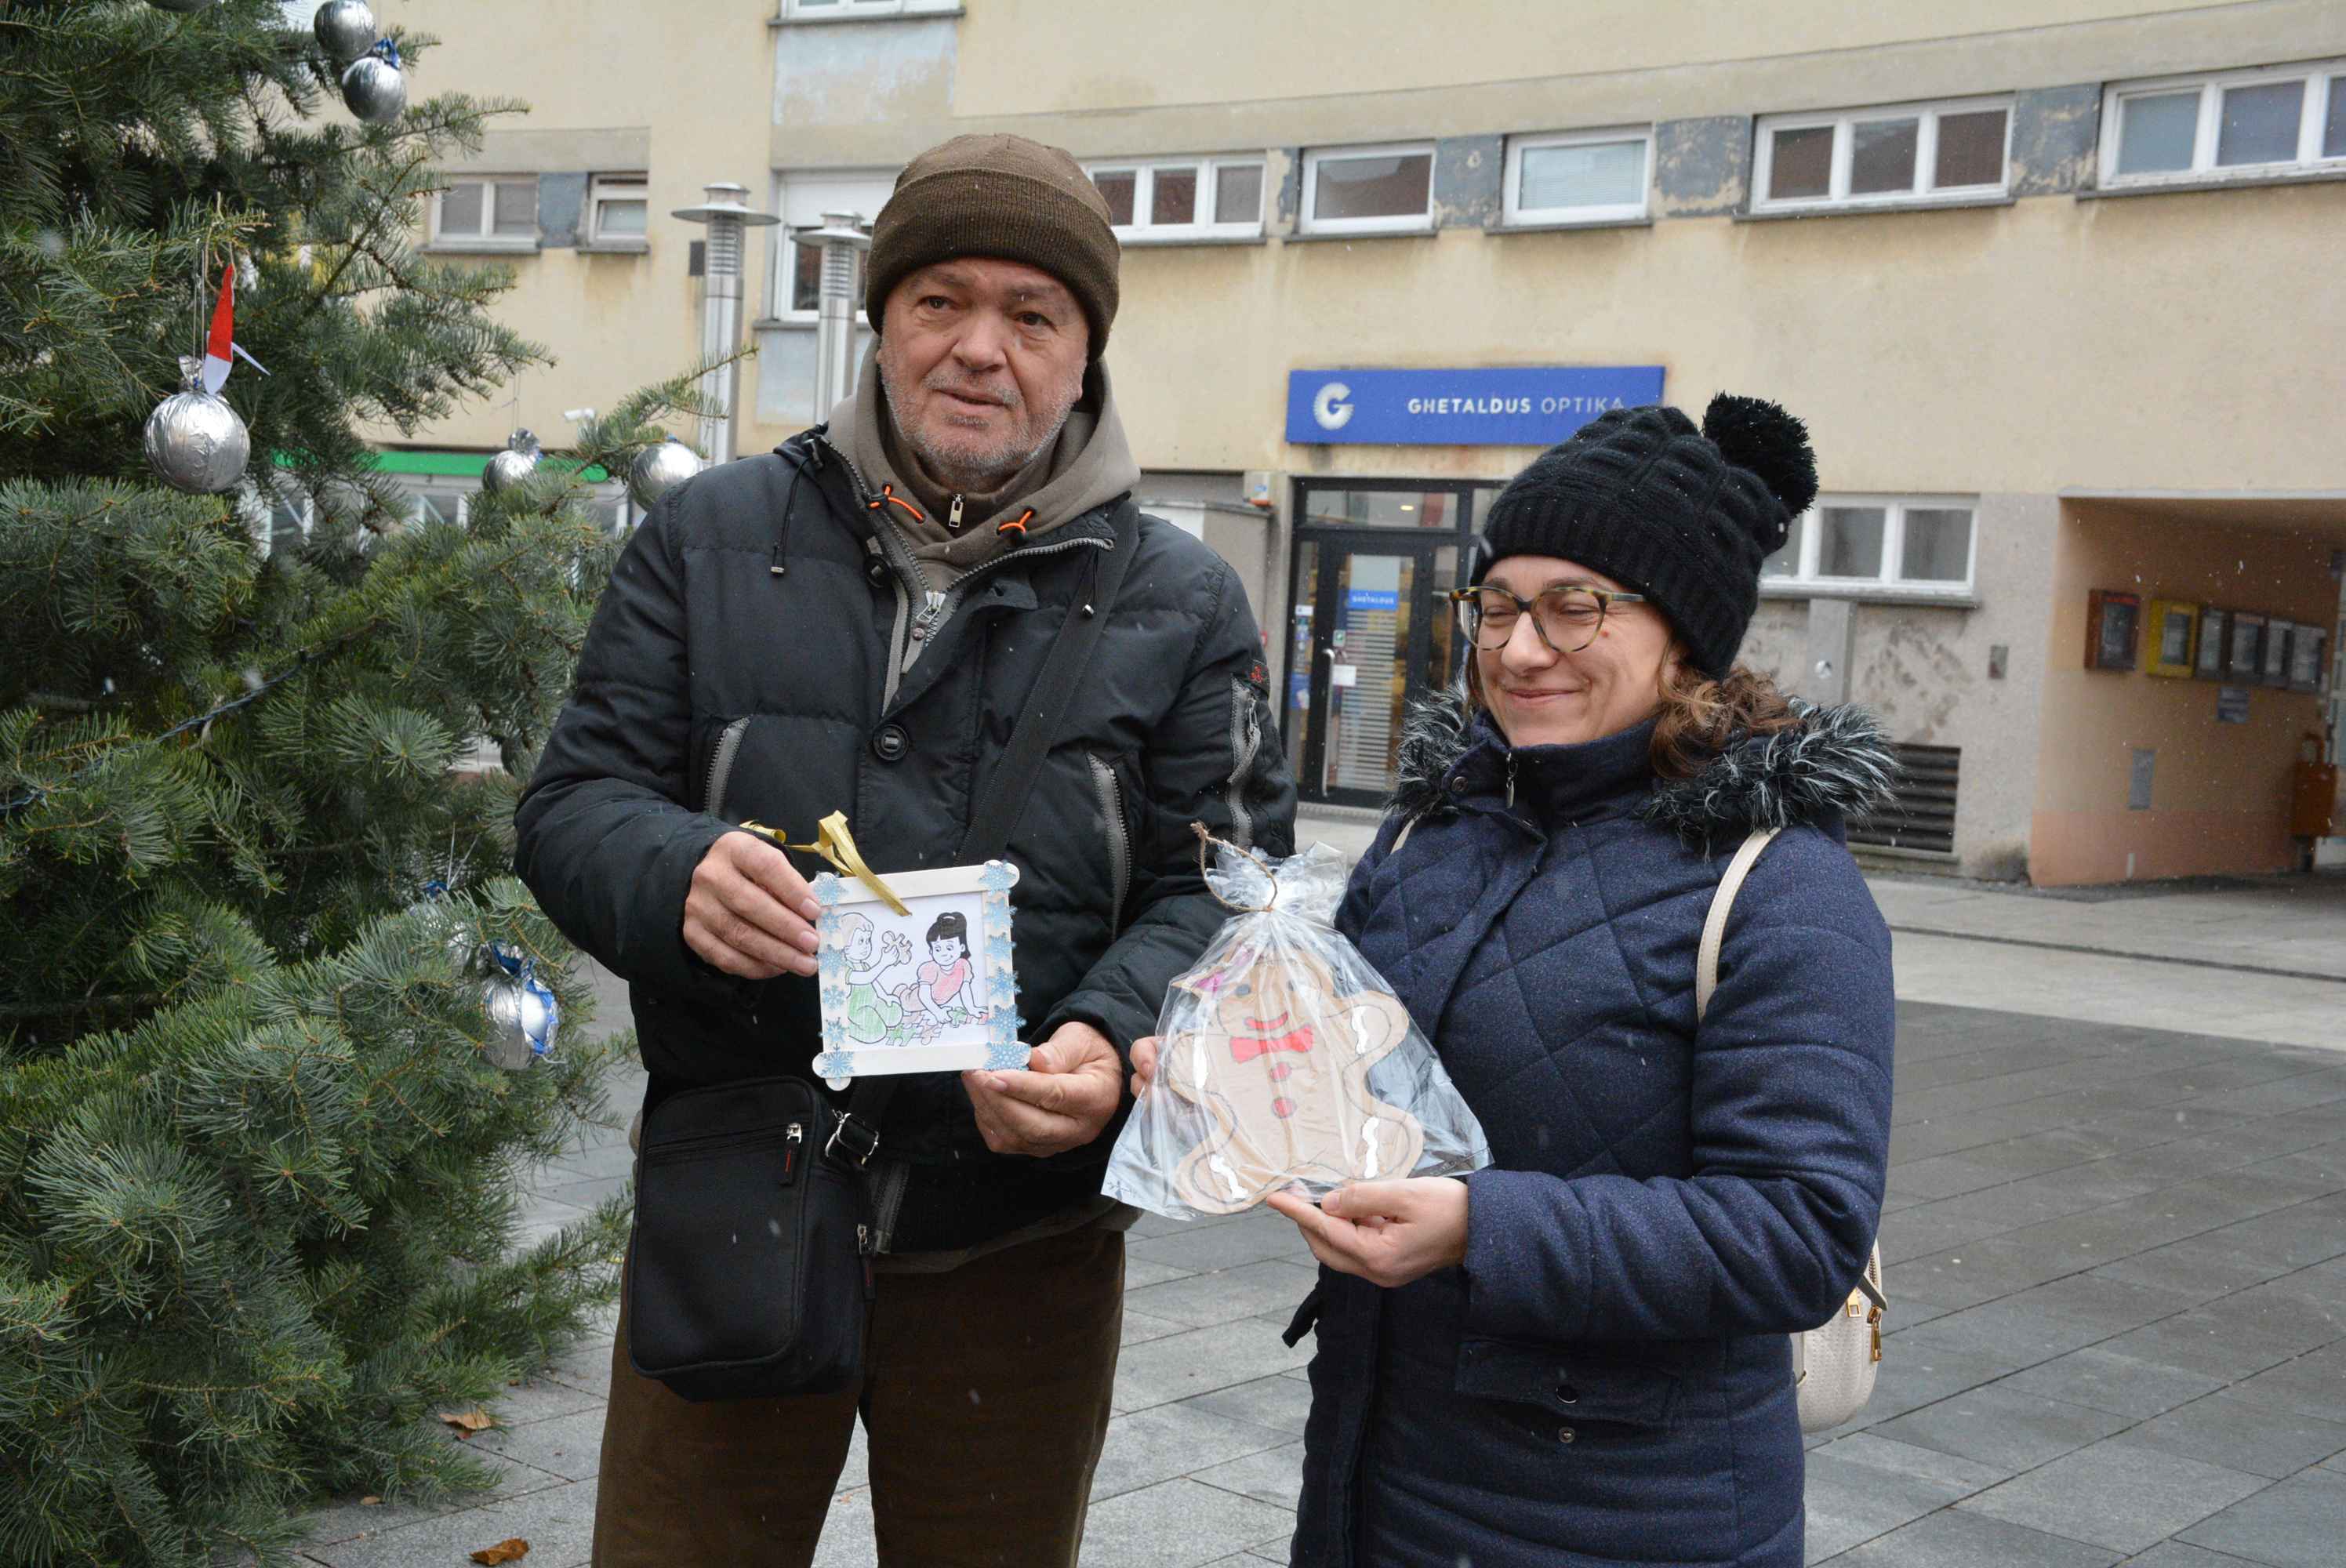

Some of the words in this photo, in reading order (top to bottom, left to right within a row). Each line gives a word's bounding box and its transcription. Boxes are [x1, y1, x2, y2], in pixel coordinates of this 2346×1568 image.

[1313, 383, 1354, 430] G
[1407, 397, 1531, 415] GHETALDUS
[1540, 396, 1625, 413] OPTIKA
